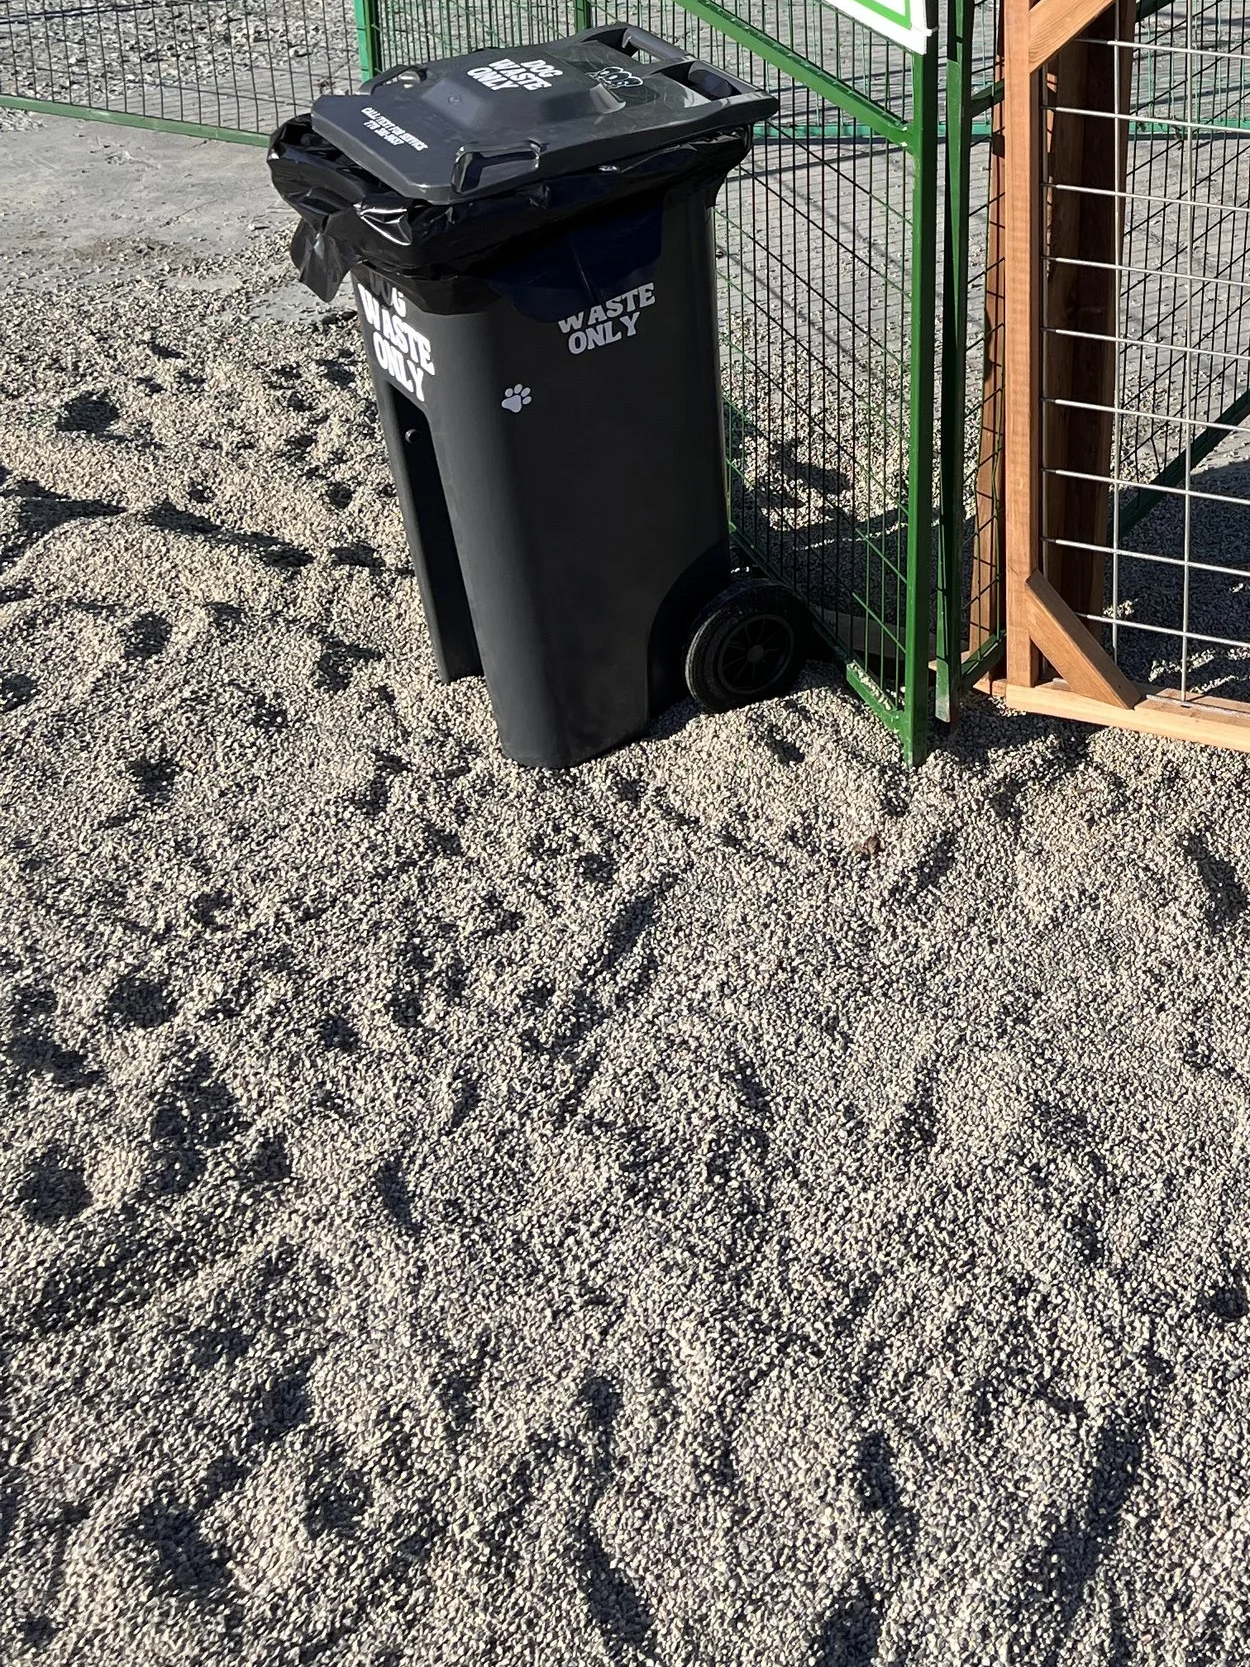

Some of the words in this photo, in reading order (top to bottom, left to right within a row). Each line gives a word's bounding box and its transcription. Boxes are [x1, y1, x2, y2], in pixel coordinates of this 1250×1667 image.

[467, 67, 520, 91] ONLY
[489, 58, 552, 91] WASTE
[520, 59, 563, 78] DOG
[557, 282, 656, 333] WASTE
[357, 283, 436, 376] WASTE
[568, 311, 641, 354] ONLY
[372, 331, 425, 402] ONLY
